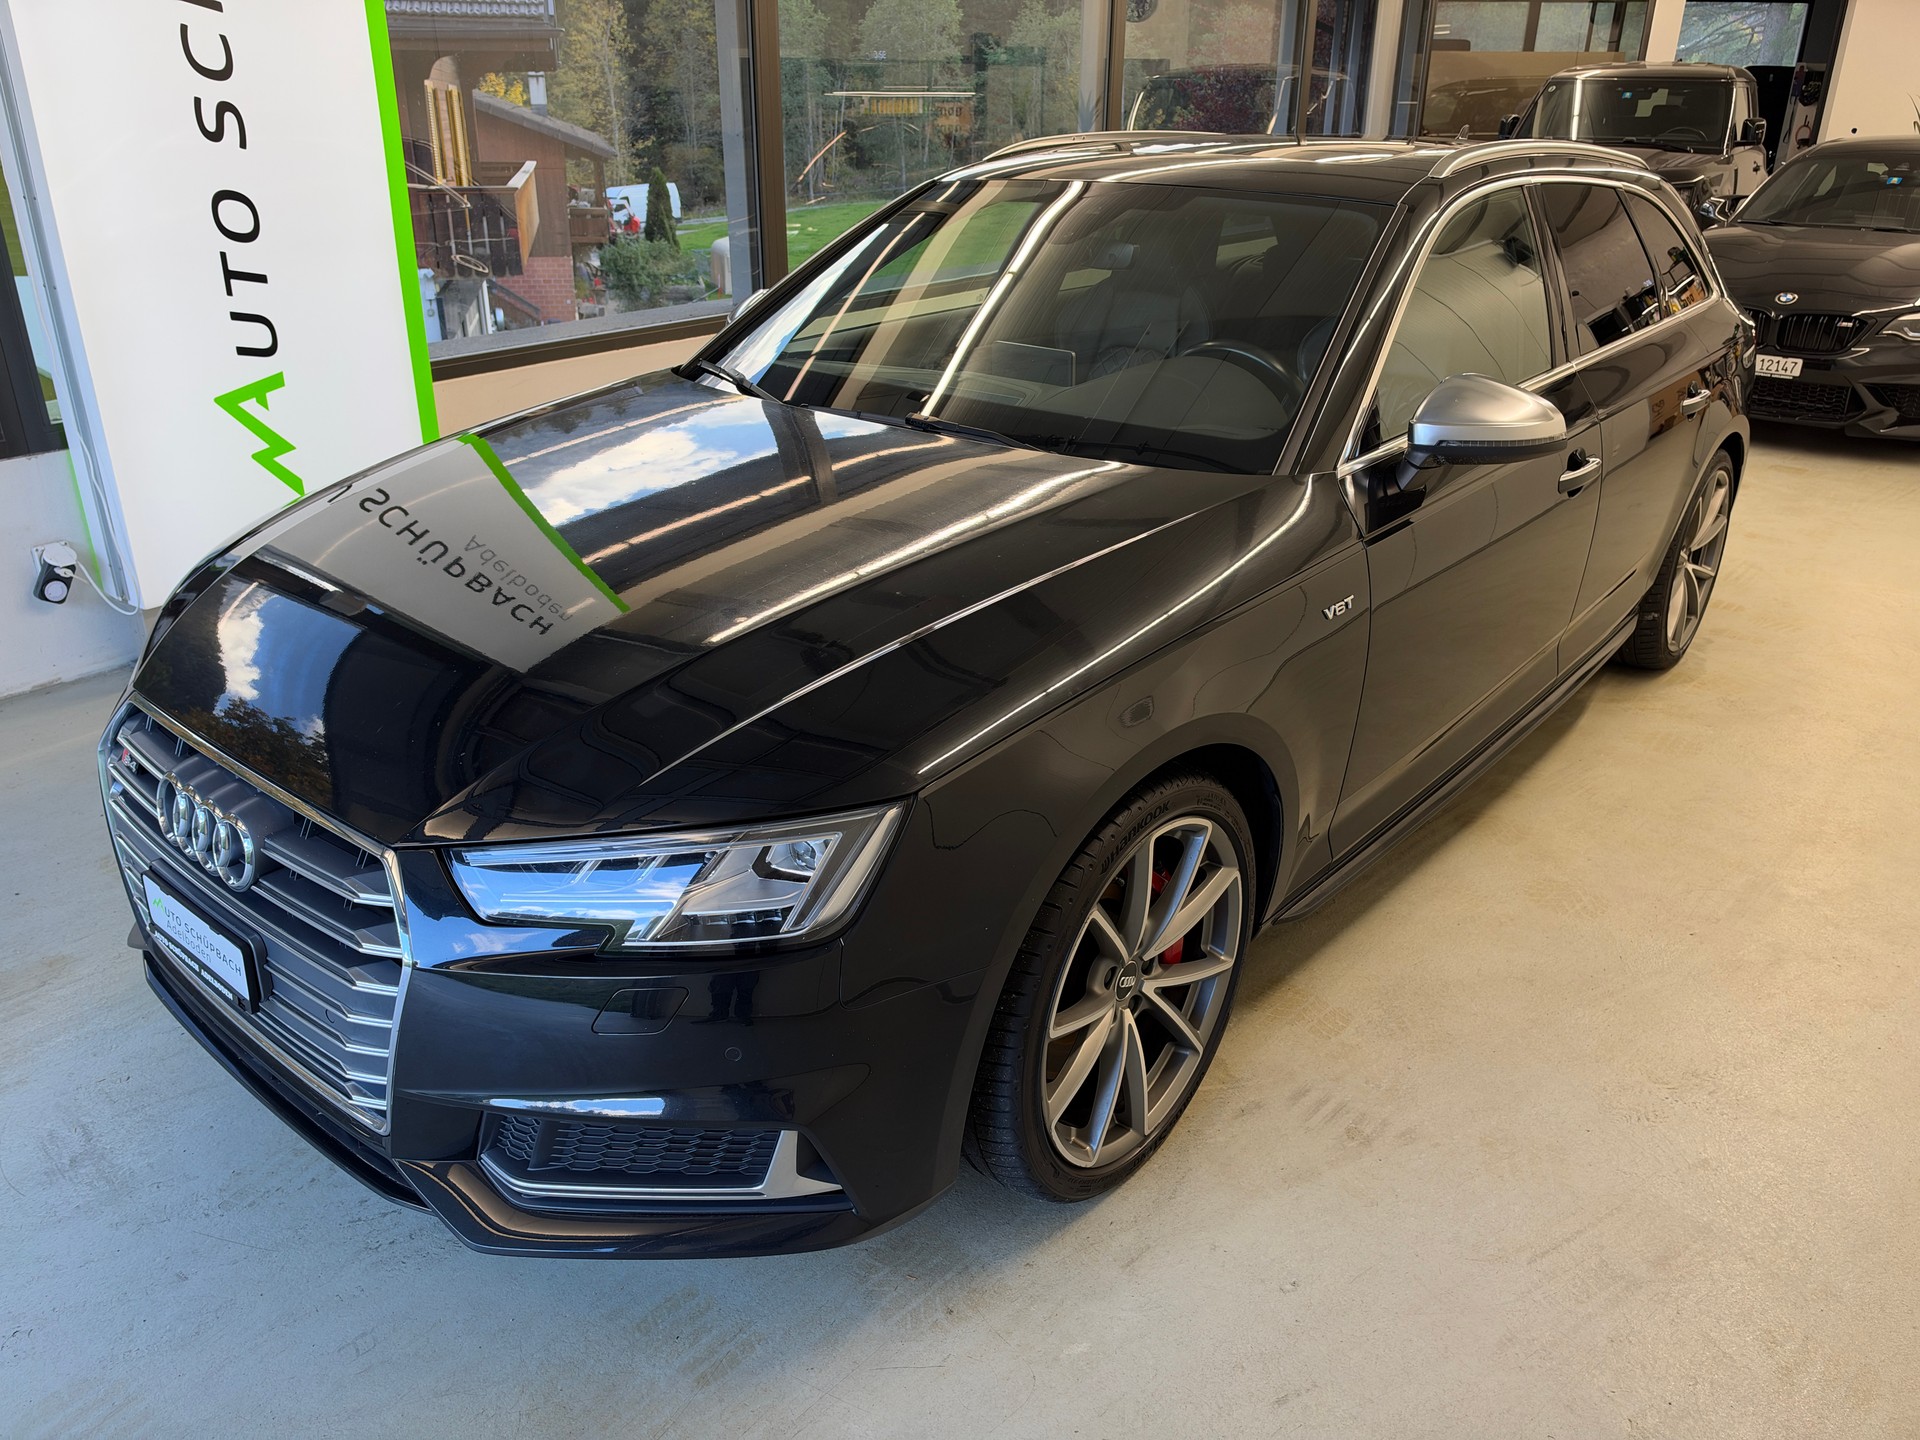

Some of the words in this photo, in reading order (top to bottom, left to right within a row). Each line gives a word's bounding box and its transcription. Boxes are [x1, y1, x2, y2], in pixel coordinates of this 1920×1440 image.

[177, 0, 247, 150] SC
[1759, 358, 1798, 374] 12147
[1321, 594, 1355, 620] V6T
[166, 920, 212, 963] Adelboden
[184, 923, 242, 977] SCHÜPBACH
